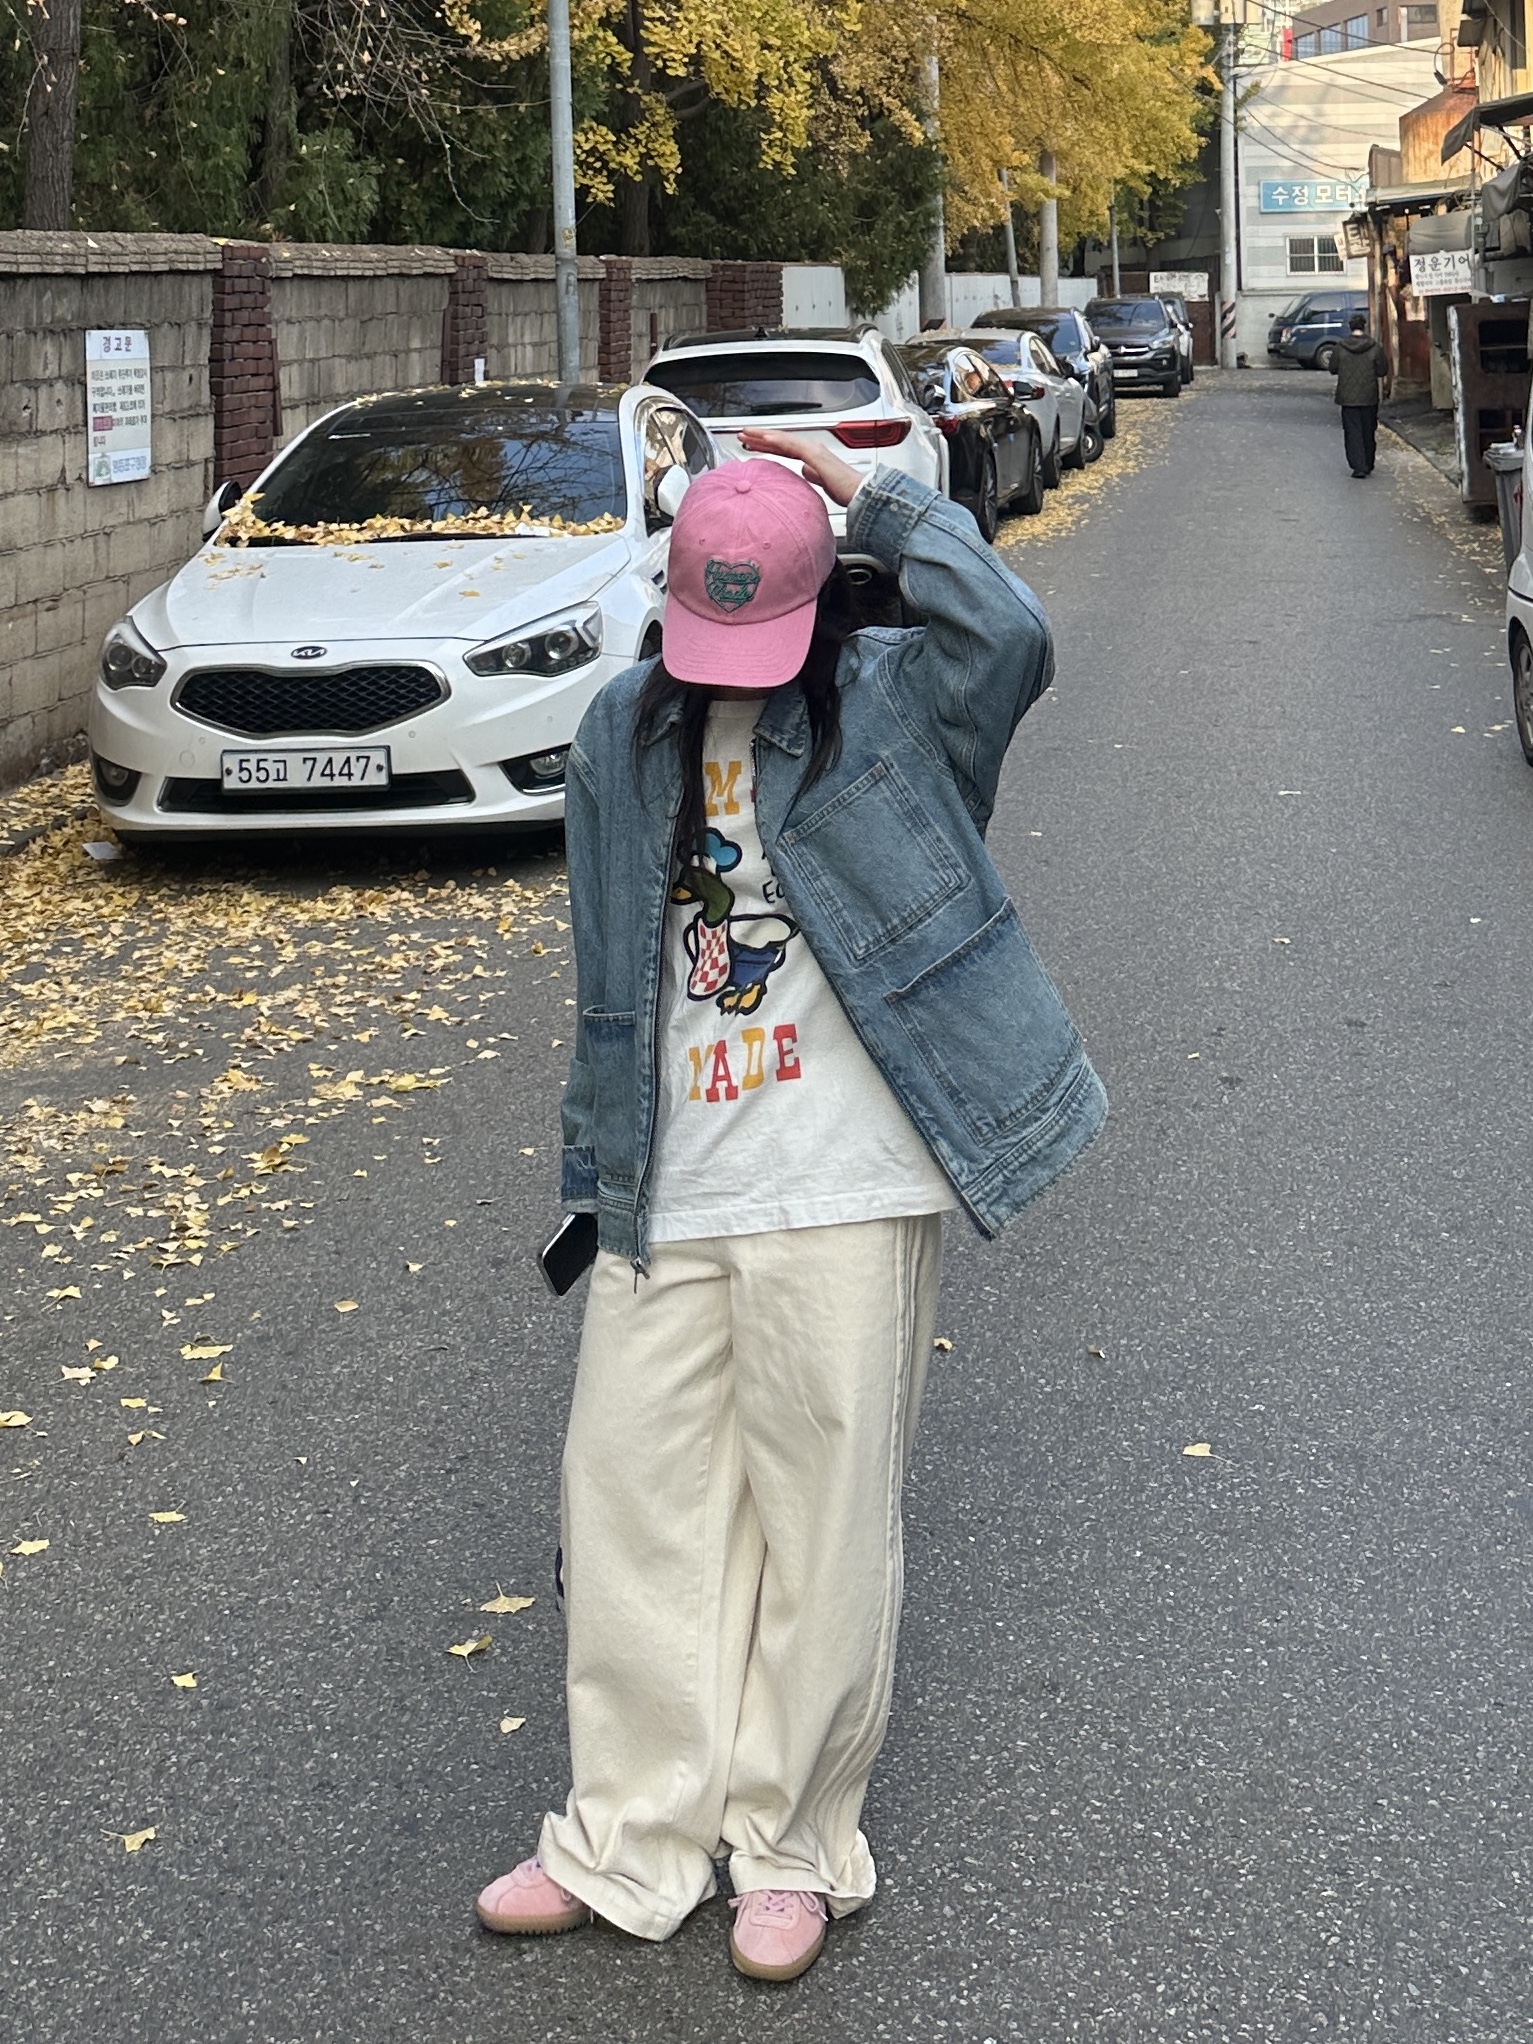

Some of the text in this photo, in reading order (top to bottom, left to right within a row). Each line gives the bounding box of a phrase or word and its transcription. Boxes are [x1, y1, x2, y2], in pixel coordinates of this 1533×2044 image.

[1271, 184, 1309, 206] 수정
[237, 755, 371, 784] 55고 7447
